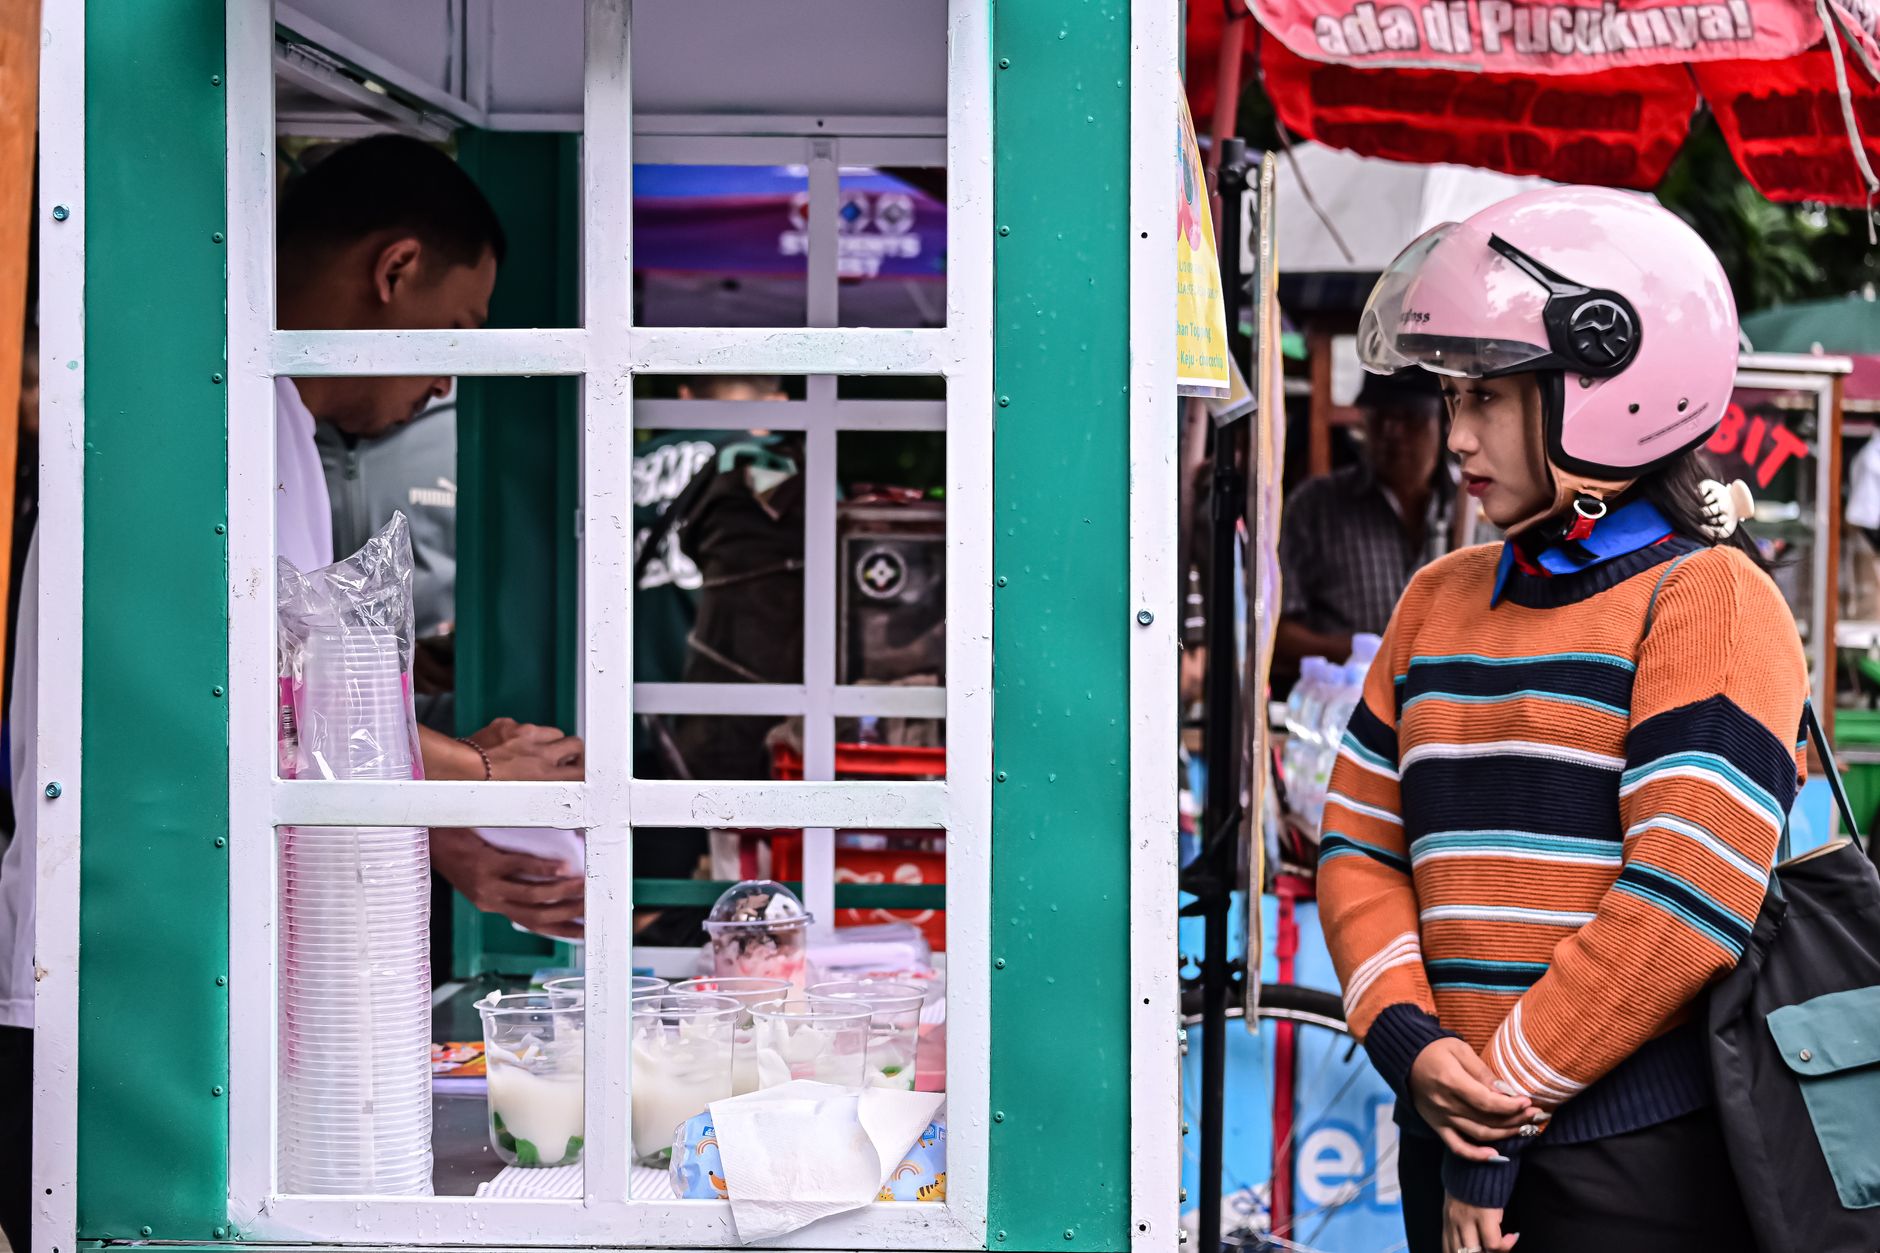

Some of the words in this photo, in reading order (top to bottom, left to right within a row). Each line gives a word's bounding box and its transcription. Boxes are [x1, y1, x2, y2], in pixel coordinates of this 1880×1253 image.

[1314, 2, 1420, 56] ada
[1421, 1, 1474, 54] di
[1479, 0, 1756, 54] Pucuknya!
